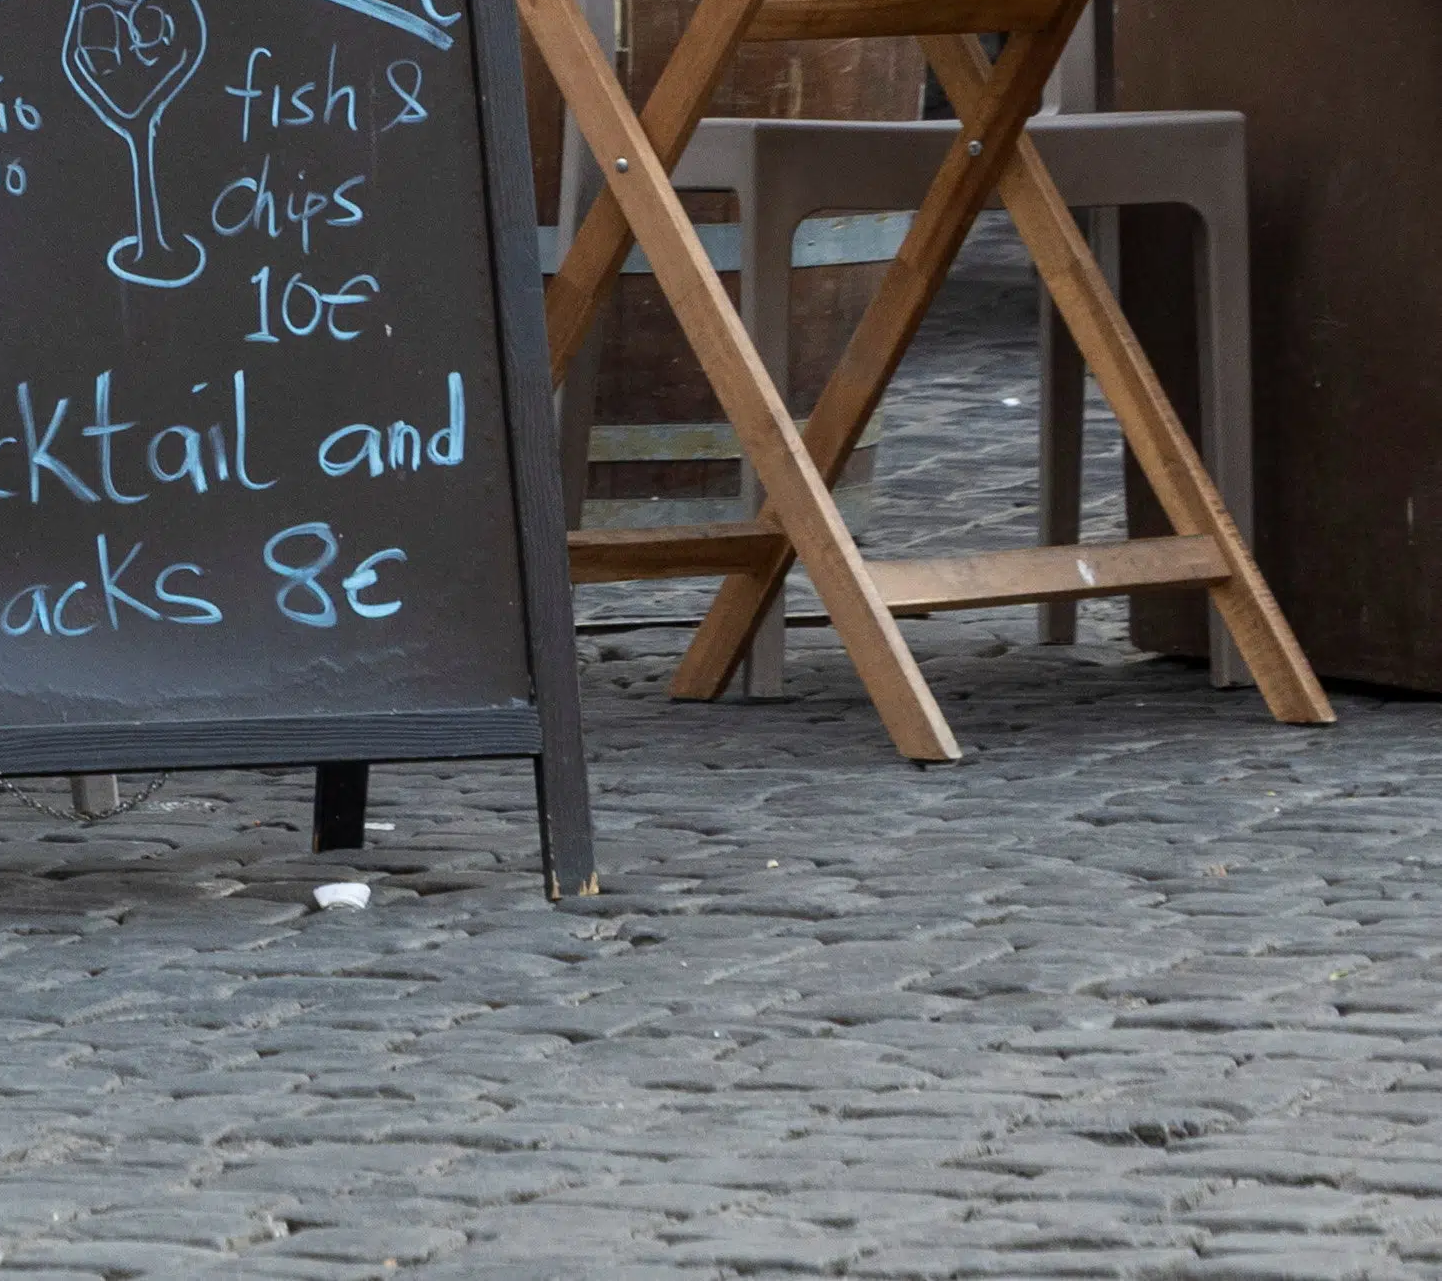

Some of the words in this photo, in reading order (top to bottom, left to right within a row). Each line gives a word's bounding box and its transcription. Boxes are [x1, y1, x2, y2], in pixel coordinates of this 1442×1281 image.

[225, 47, 359, 143] fish
[211, 169, 366, 254] chips
[244, 266, 382, 345] 10€
[318, 371, 468, 479] and
[262, 521, 409, 629] 8€
